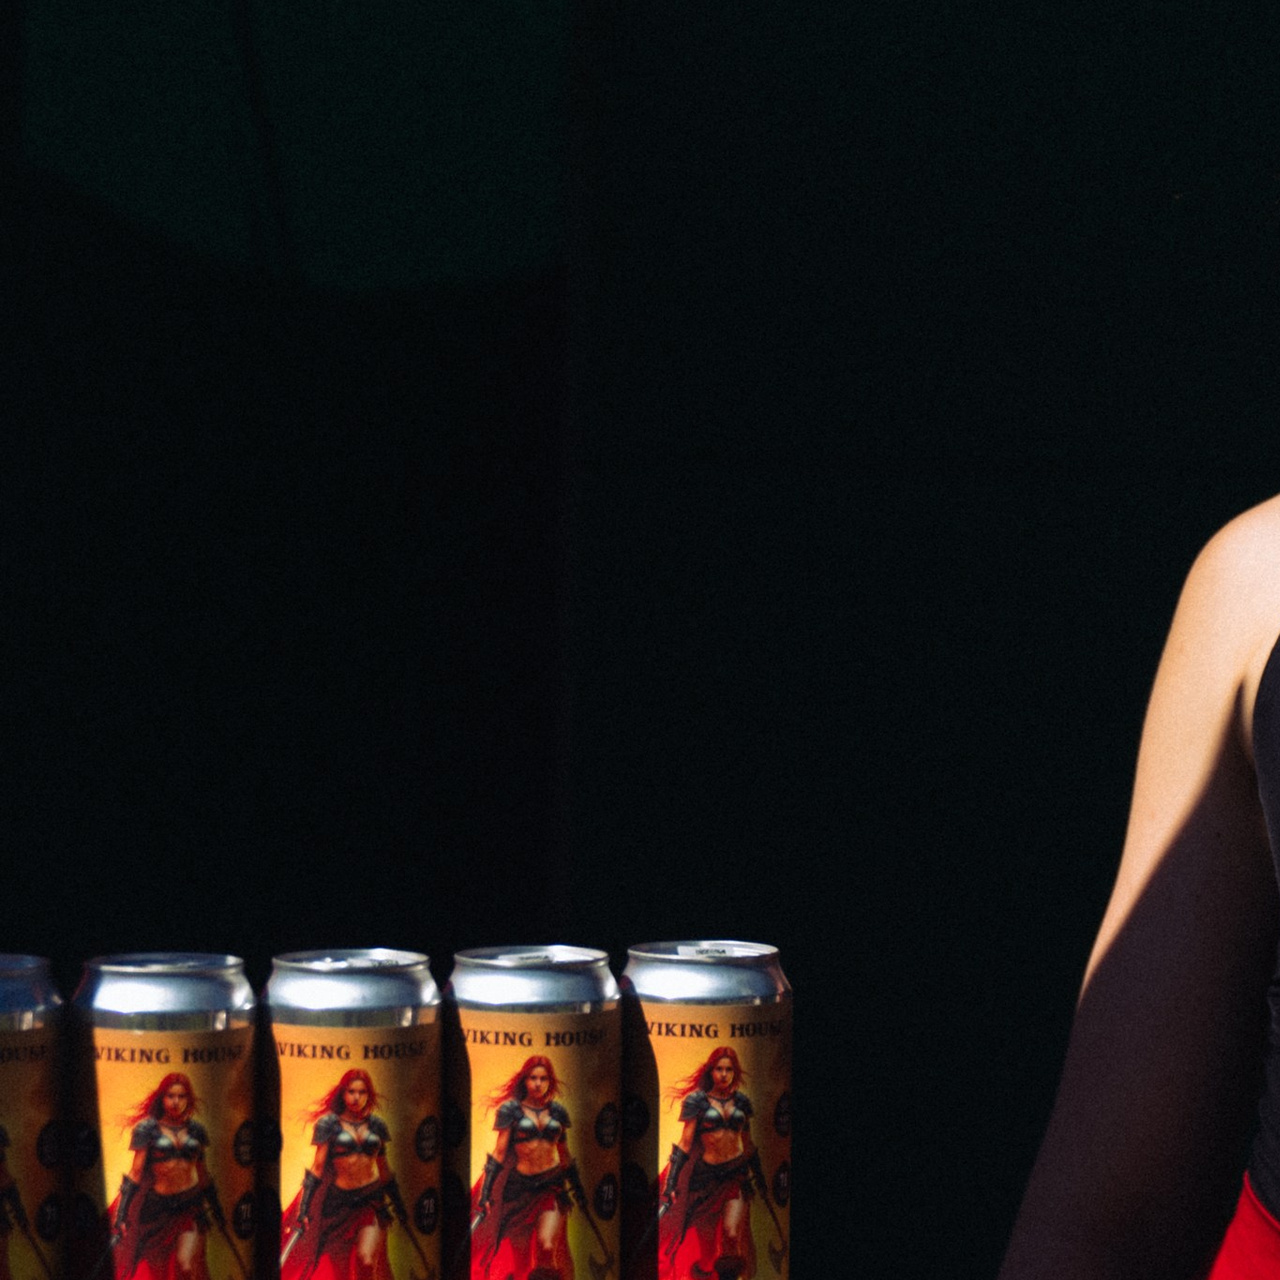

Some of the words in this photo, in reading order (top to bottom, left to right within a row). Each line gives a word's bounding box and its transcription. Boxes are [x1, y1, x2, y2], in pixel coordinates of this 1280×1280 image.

[462, 1029, 532, 1047] VIKING
[646, 1021, 719, 1038] VIKING
[96, 1046, 171, 1064] VIKING
[277, 1041, 352, 1060] VIKING
